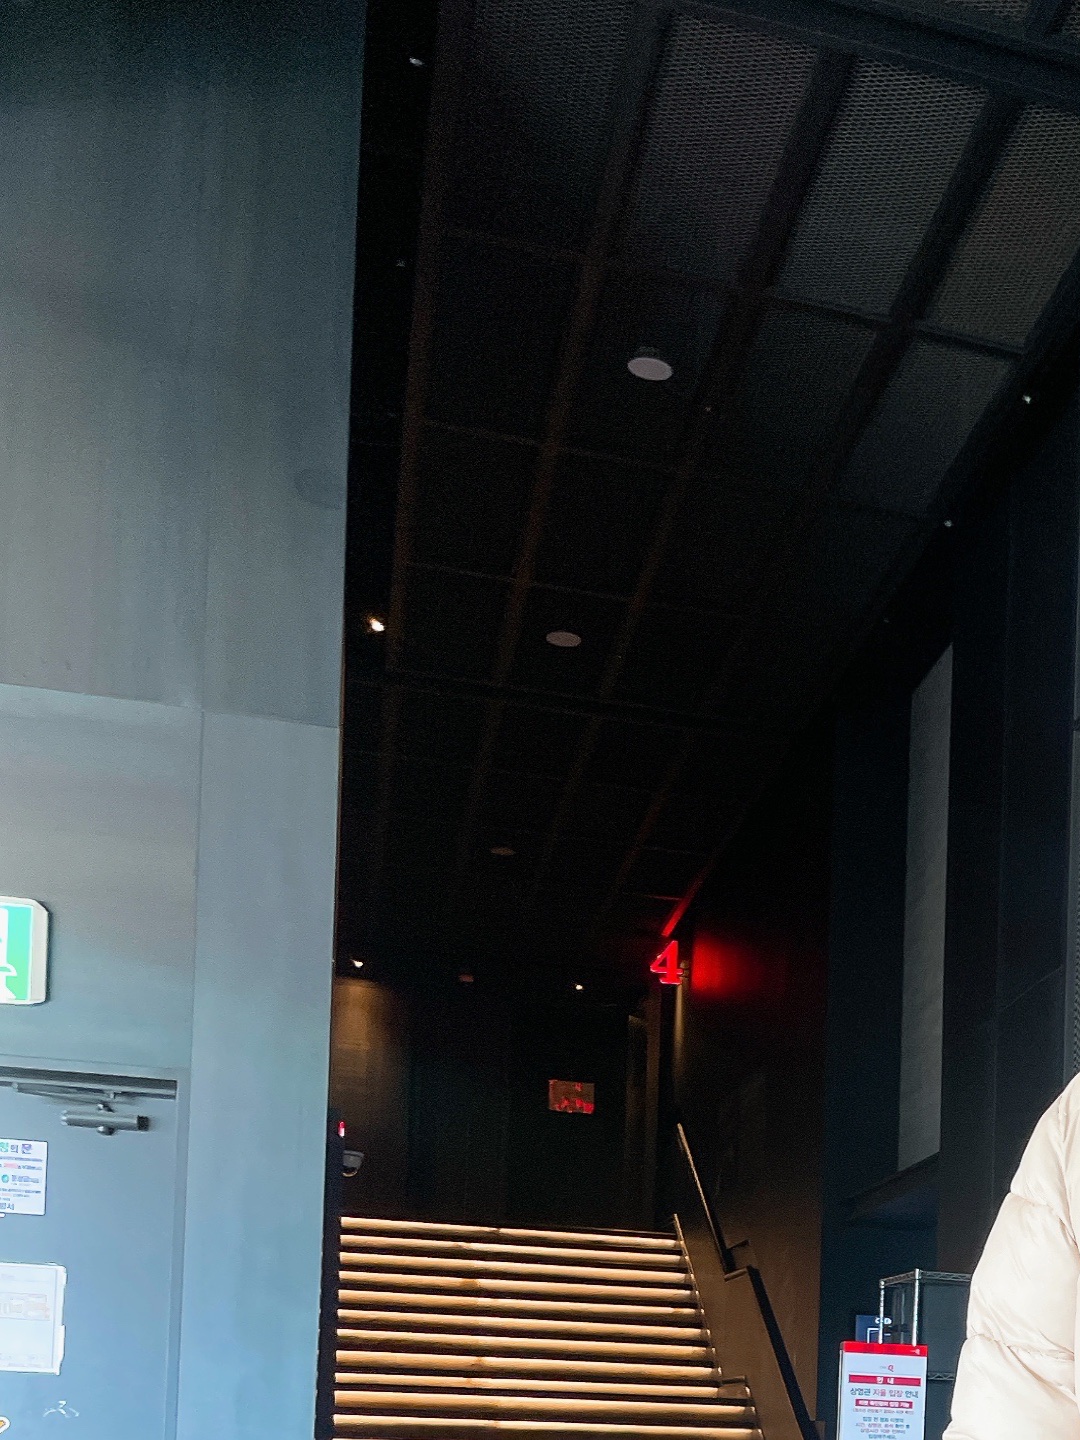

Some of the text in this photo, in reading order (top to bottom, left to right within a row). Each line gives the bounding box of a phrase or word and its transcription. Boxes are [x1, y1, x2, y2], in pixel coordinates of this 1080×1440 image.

[650, 940, 683, 985] 4
[850, 1387, 919, 1399] 상영관 자율 입장 안내
